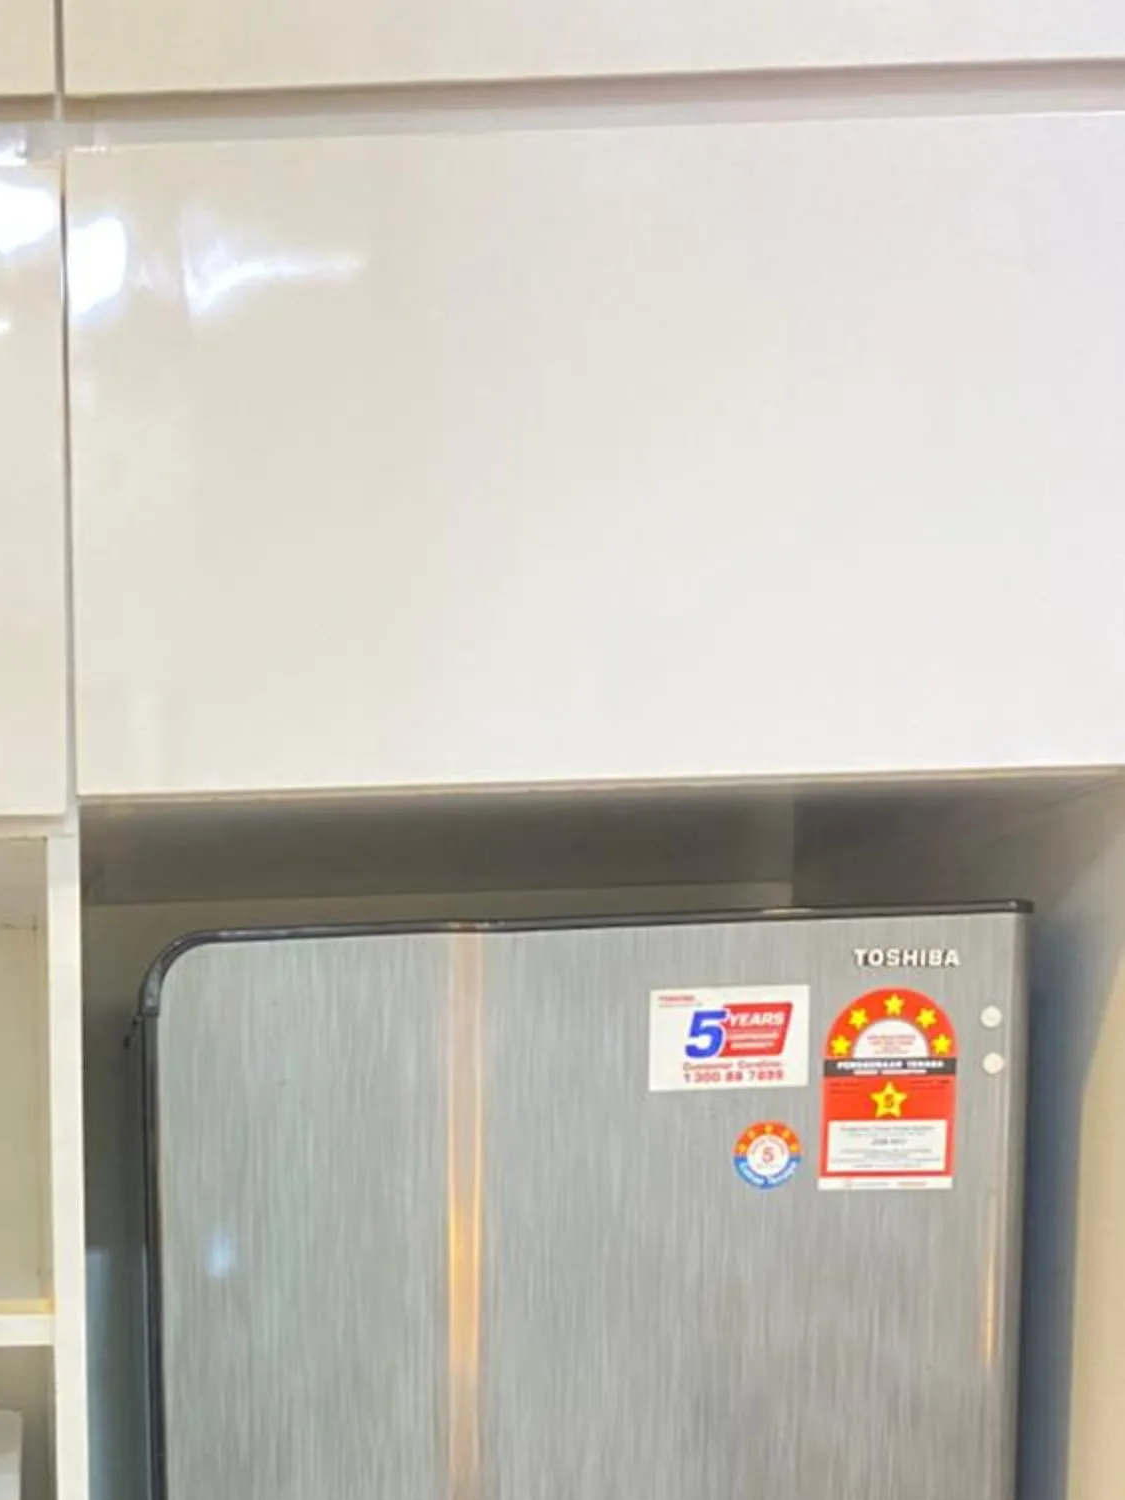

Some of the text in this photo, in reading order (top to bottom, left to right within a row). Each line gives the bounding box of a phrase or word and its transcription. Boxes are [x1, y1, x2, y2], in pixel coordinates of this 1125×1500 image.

[853, 948, 961, 967] TOSHIBA
[684, 1010, 785, 1058] 5 YEARS
